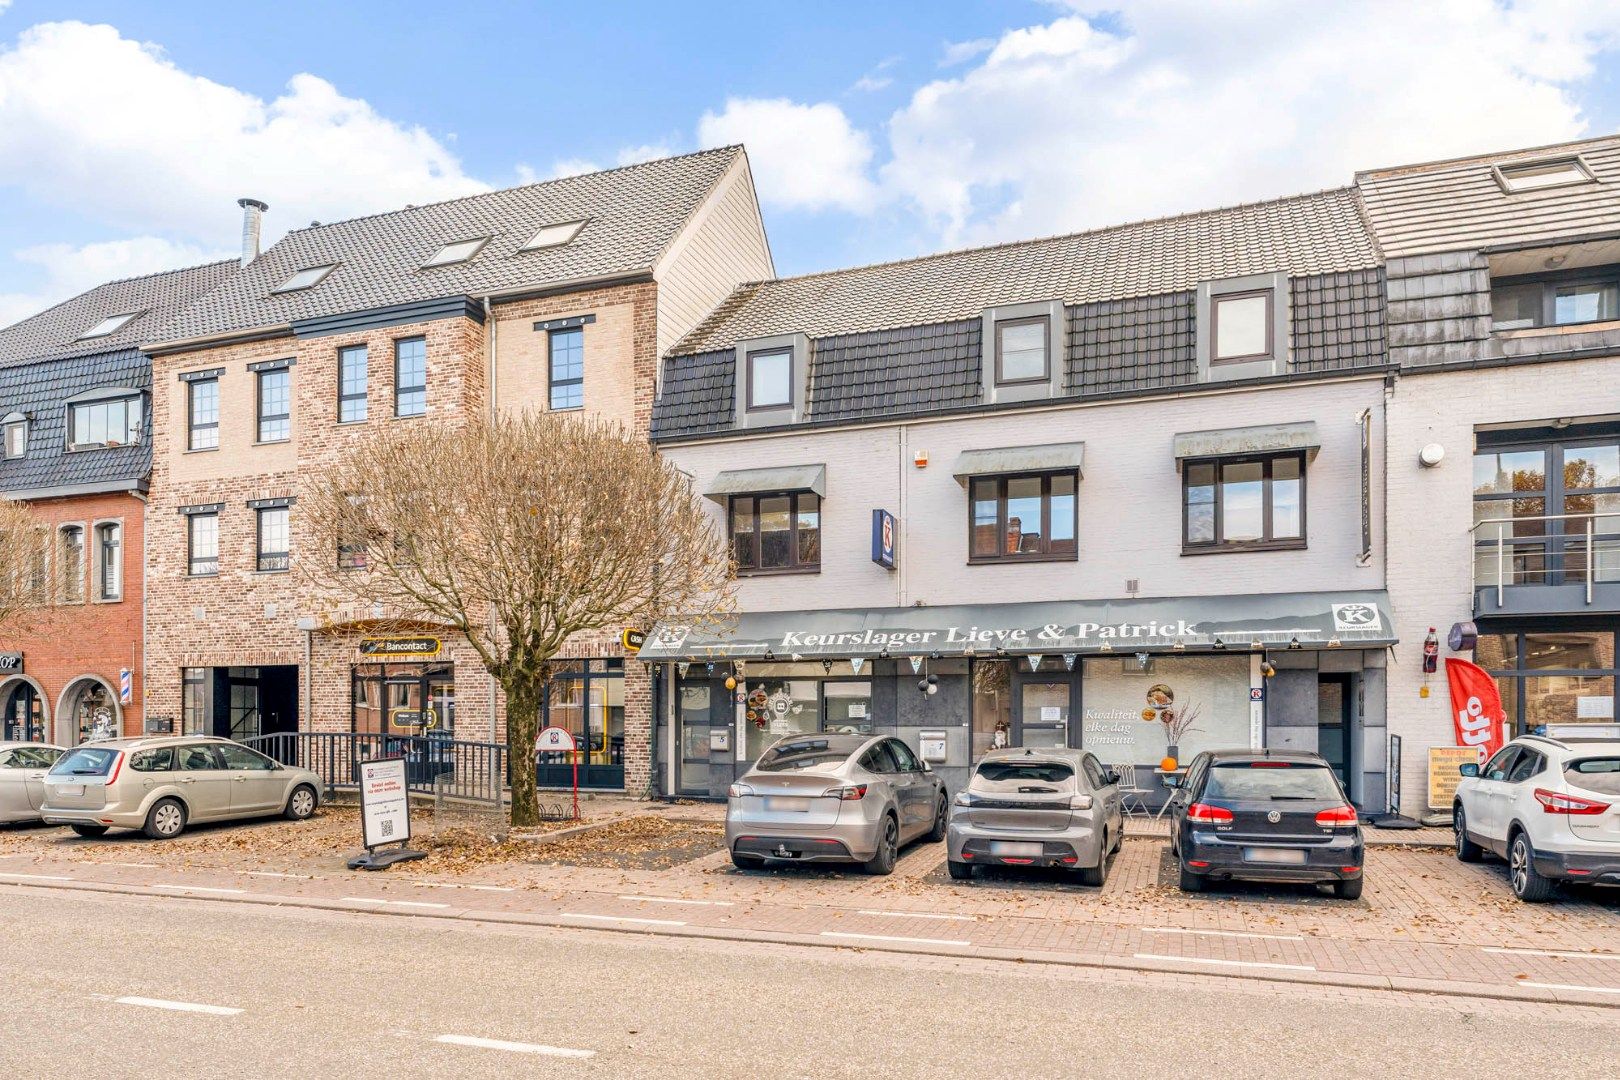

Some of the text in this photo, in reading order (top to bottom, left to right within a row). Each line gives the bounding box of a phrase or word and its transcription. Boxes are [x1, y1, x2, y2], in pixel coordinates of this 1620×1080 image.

[780, 620, 1199, 648] Keurslager Lieve & Patrick
[386, 642, 427, 651] Bancontact
[0, 657, 16, 669] OP
[1085, 722, 1131, 735] elke dag
[1459, 696, 1491, 766] otto
